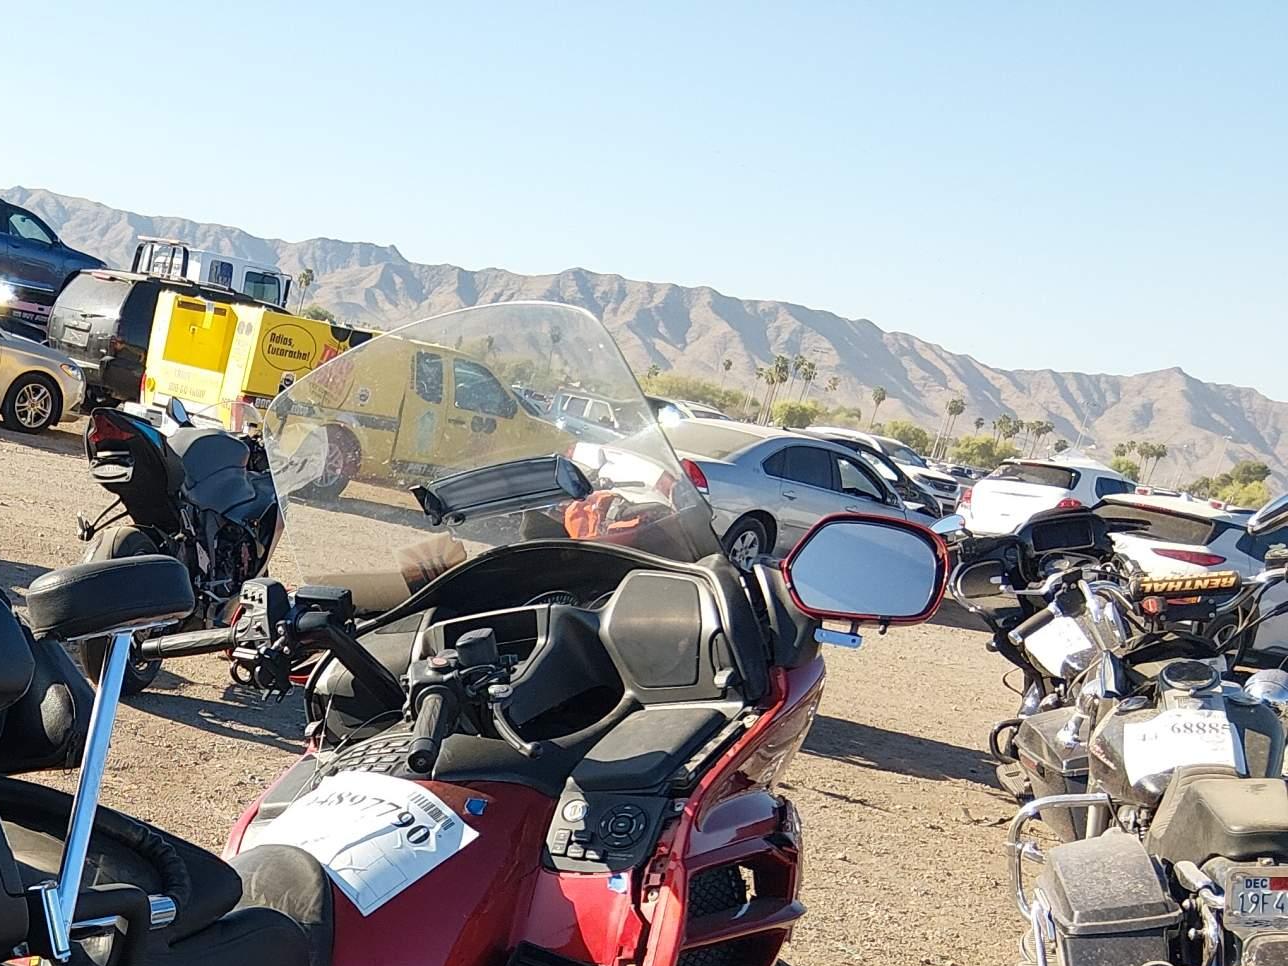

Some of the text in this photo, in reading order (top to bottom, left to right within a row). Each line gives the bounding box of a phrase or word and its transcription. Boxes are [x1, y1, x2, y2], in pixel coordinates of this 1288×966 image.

[270, 332, 295, 348] Adios,
[267, 343, 311, 362] Cucaracha!
[1140, 576, 1237, 593] RENTHAL
[1245, 879, 1268, 889] DEC
